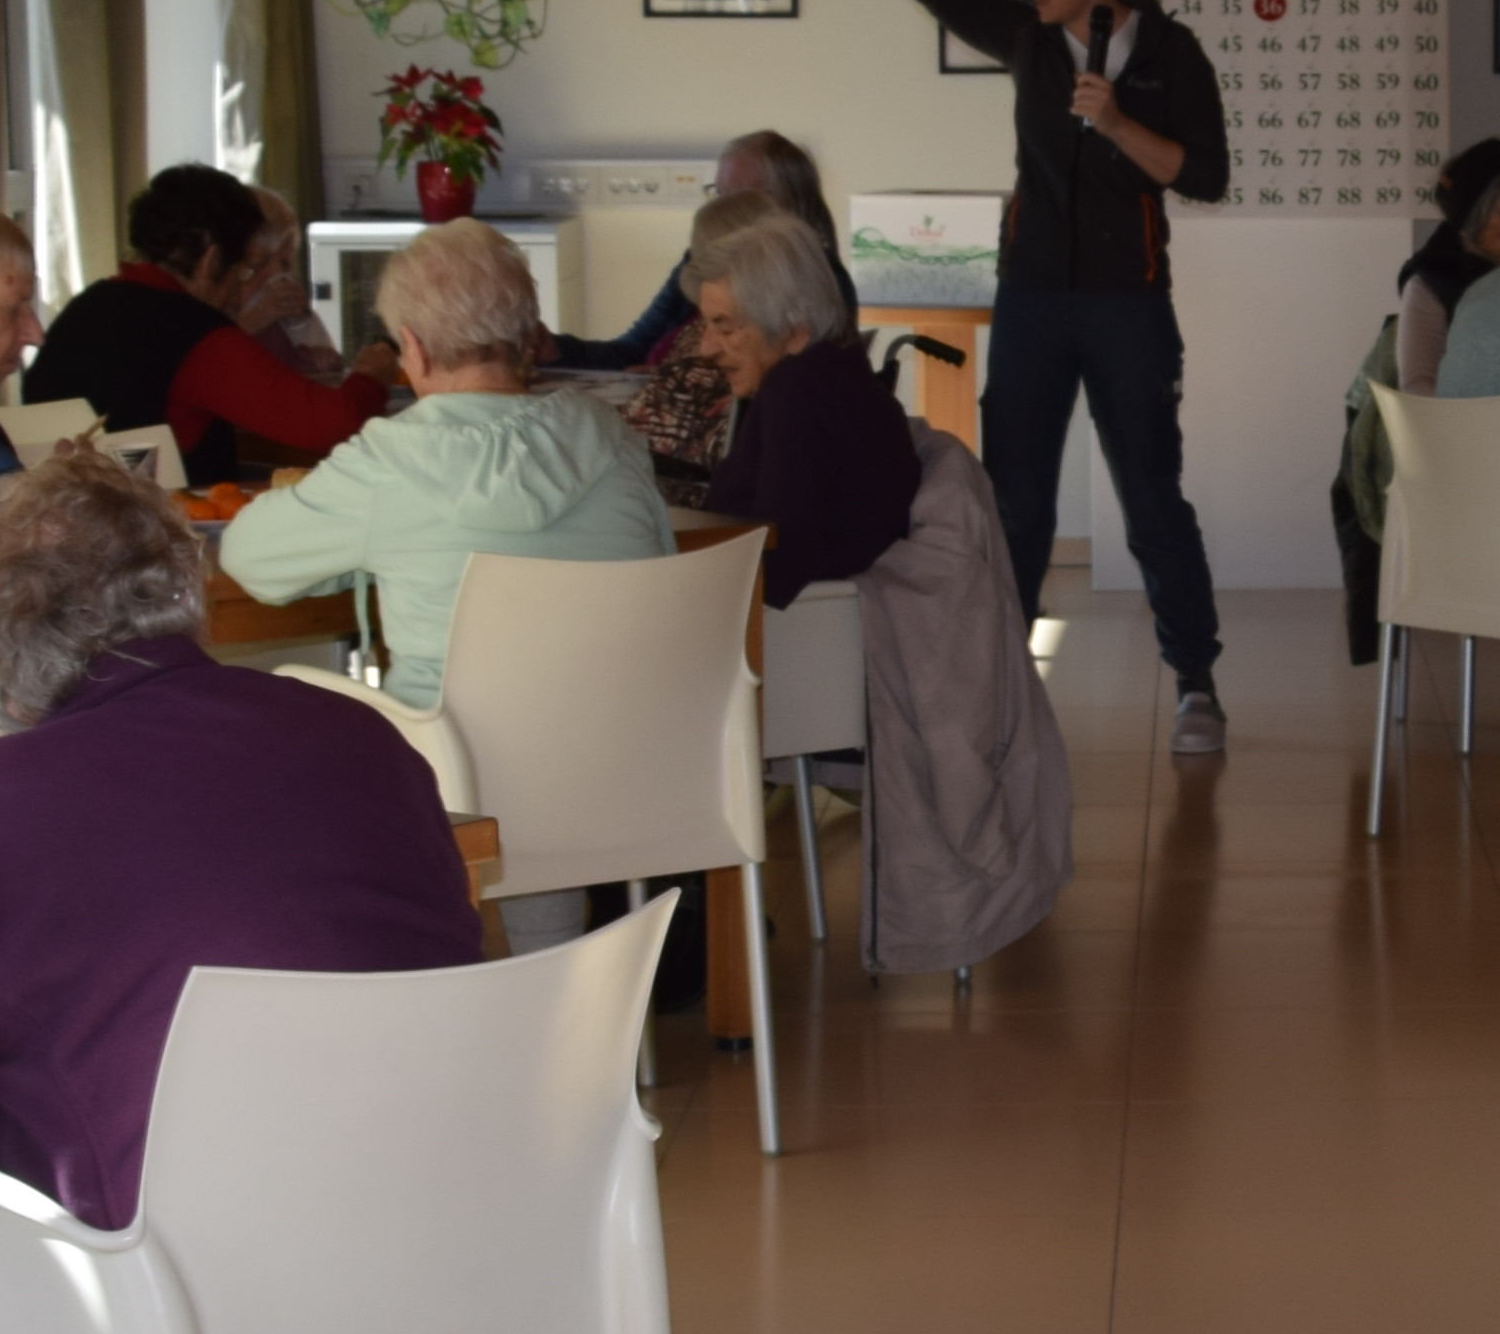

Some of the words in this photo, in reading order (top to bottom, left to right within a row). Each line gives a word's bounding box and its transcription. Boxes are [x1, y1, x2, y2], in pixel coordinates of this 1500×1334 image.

[1413, 0, 1438, 15] 40
[1219, 35, 1243, 52] 45
[1258, 37, 1282, 52] 46
[1297, 35, 1321, 52] 47
[1336, 36, 1360, 52] 48
[1375, 36, 1399, 52] 49
[1415, 35, 1438, 53] 50
[1219, 73, 1243, 90] 55
[1260, 73, 1283, 90] 56
[1299, 73, 1321, 90] 57
[1338, 73, 1360, 90] 58
[1377, 73, 1400, 90] 59
[1413, 74, 1438, 91] 60
[1257, 112, 1283, 128] 66
[1297, 111, 1322, 128] 67
[1336, 112, 1361, 128] 68
[1375, 111, 1400, 128] 69
[1415, 111, 1439, 129] 70
[1259, 149, 1283, 166] 76
[1298, 149, 1322, 167] 77
[1337, 149, 1361, 166] 78
[1376, 149, 1401, 166] 79
[1415, 149, 1440, 167] 80
[1259, 188, 1284, 204] 86
[1298, 187, 1322, 205] 87
[1337, 188, 1361, 204] 88
[1377, 187, 1401, 204] 89
